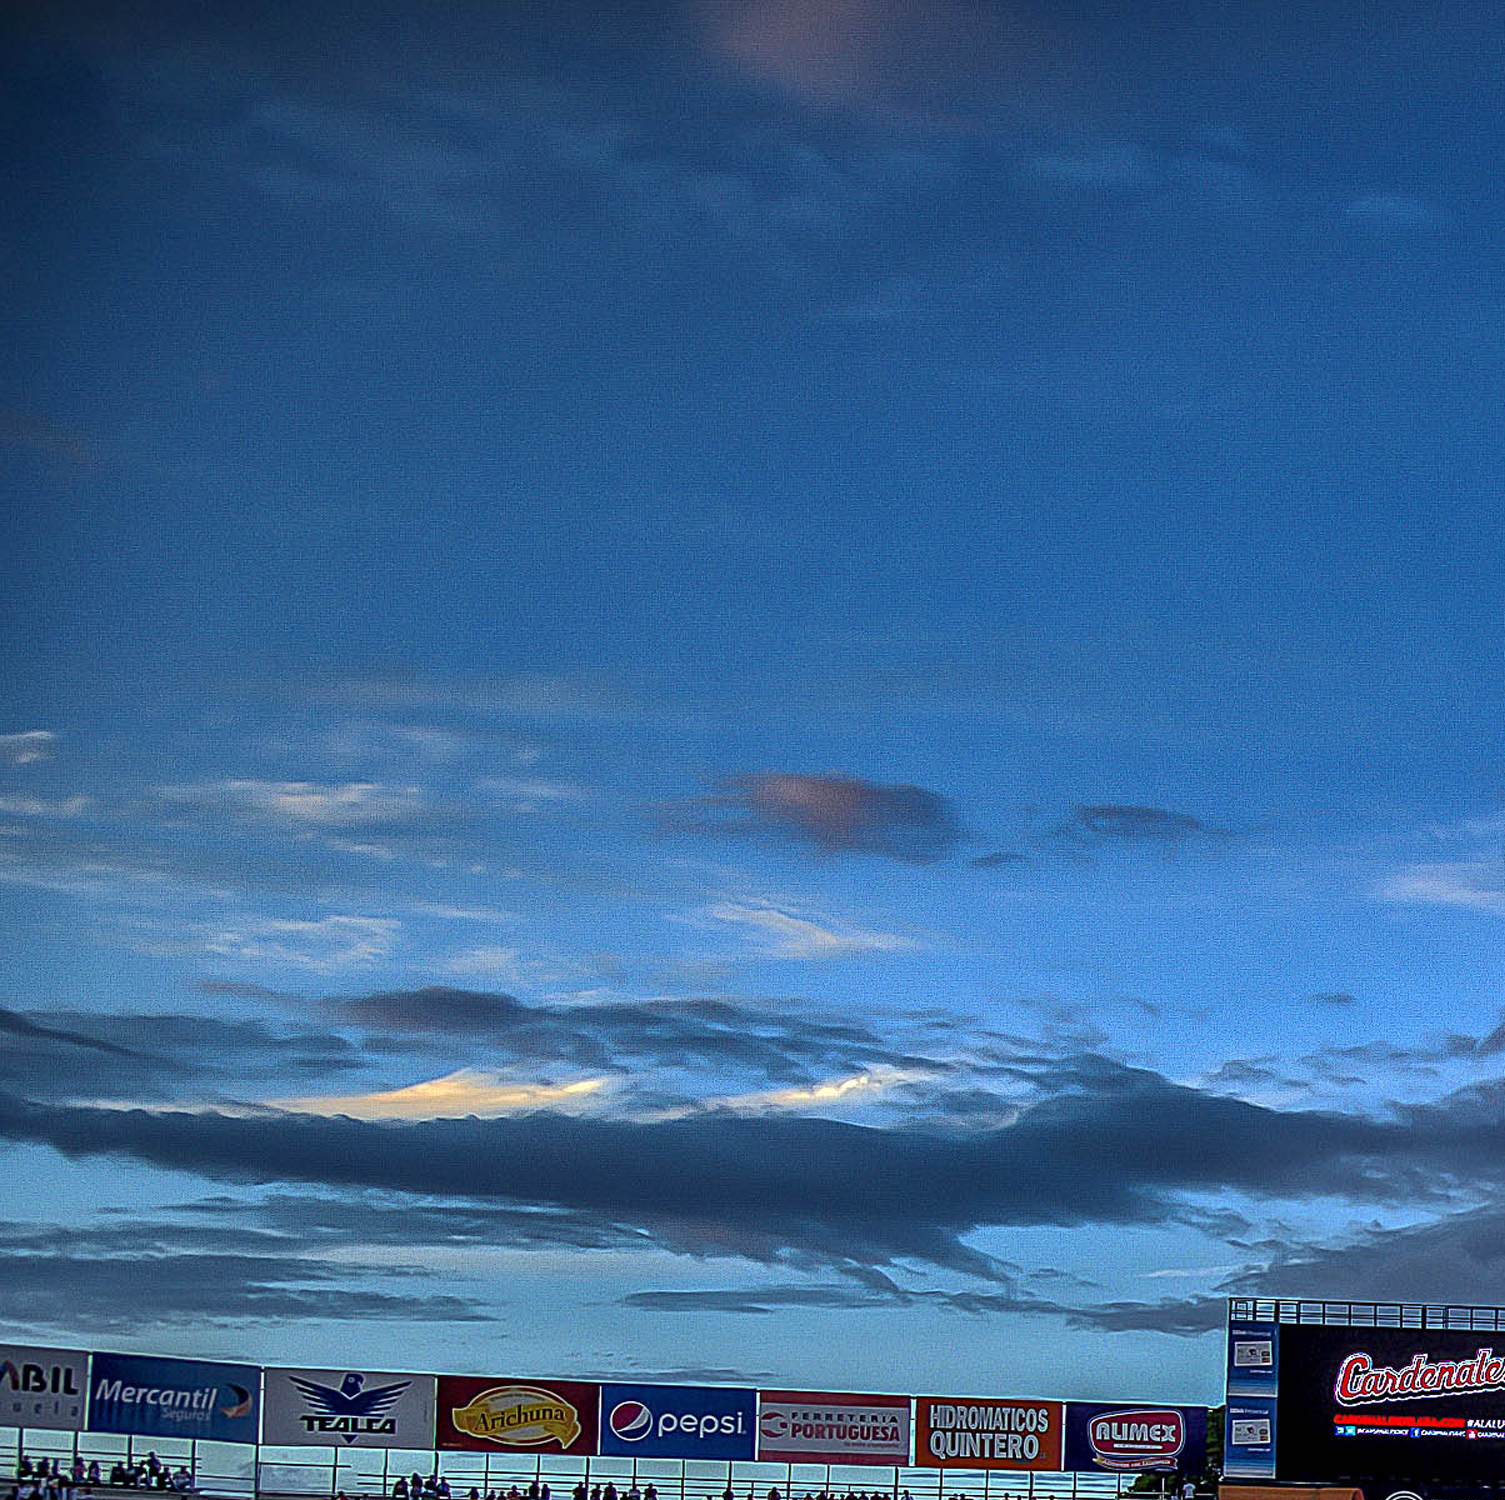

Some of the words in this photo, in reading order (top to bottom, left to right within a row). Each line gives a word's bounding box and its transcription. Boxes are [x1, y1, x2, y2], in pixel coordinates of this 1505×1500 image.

[96, 1379, 218, 1410] Mercantil
[162, 1406, 211, 1421] Seguros
[300, 1415, 396, 1434] TEALCA
[475, 1404, 565, 1432] Arichuna
[658, 1411, 743, 1438] pepsi
[930, 1404, 1049, 1433] HIDROMATICOS
[791, 1422, 900, 1441] PORTUGUESA
[1096, 1421, 1177, 1442] ALIMEX
[930, 1431, 1040, 1460] QUINTERO
